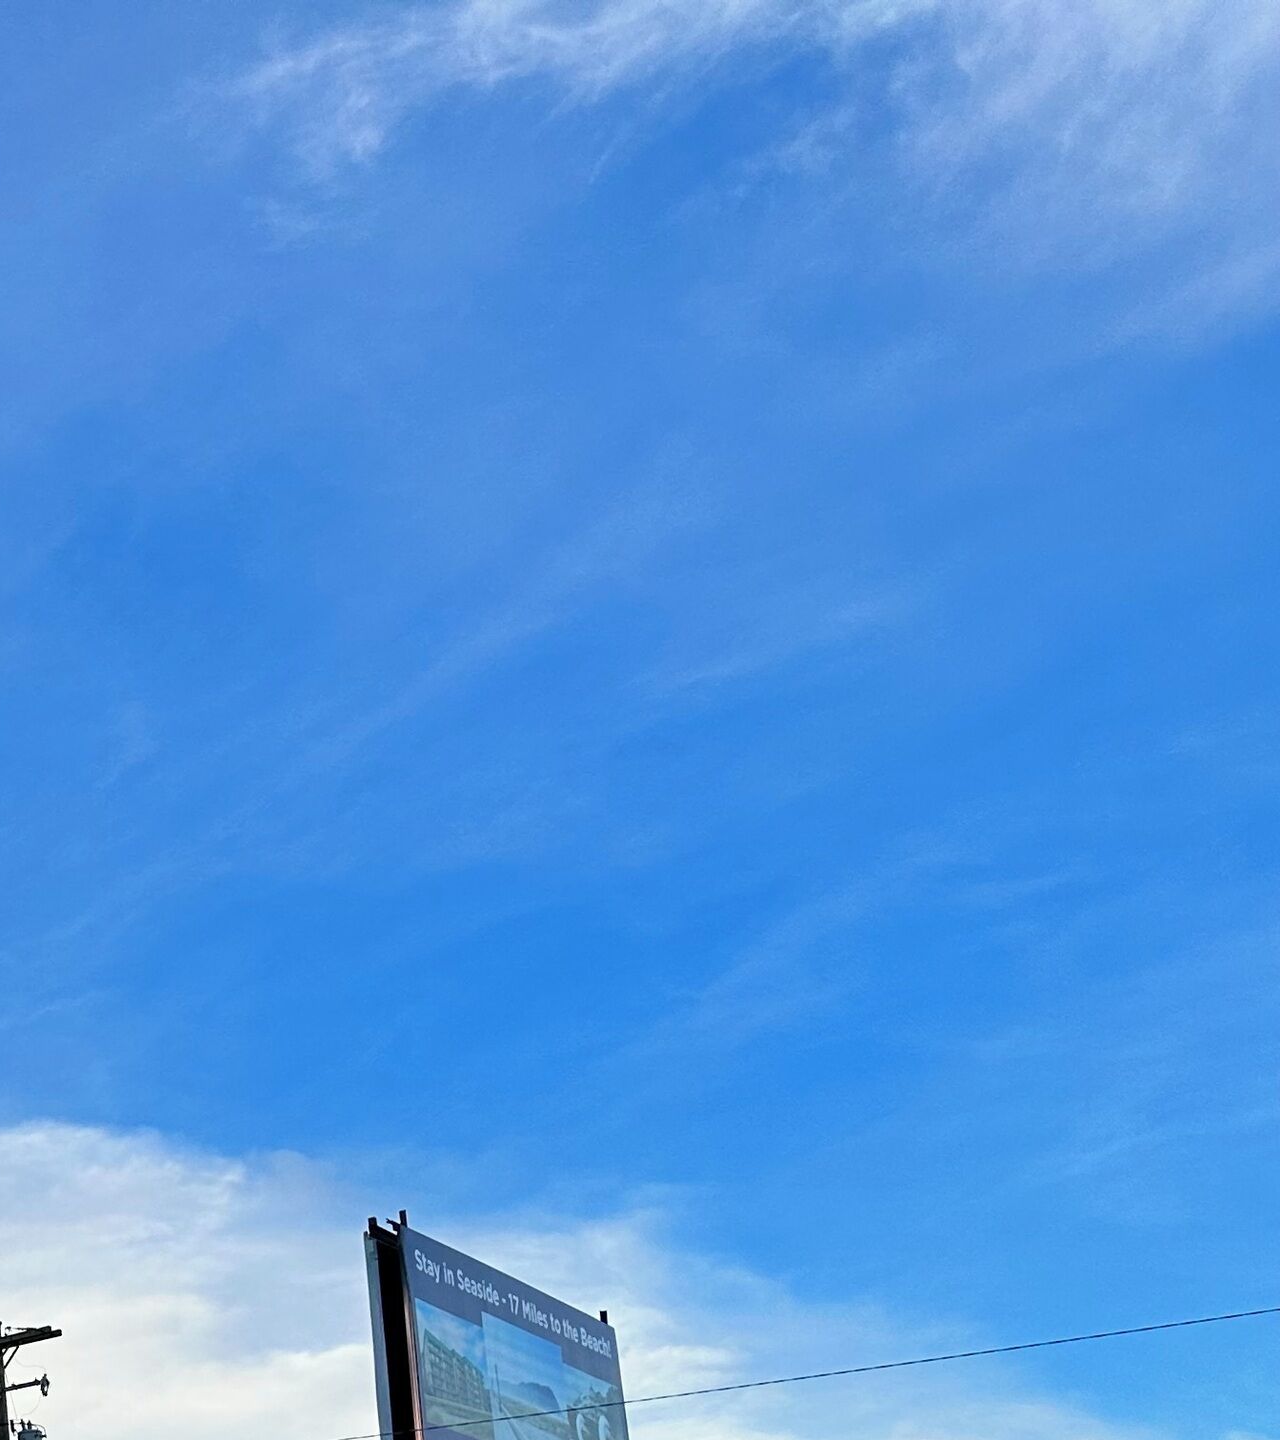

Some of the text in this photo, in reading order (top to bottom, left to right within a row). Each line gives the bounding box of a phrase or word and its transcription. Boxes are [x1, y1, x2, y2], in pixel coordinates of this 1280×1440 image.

[414, 1249, 440, 1284] Stay
[443, 1262, 454, 1287] in
[457, 1268, 500, 1306] Seaside
[508, 1293, 519, 1315] 17
[522, 1300, 548, 1330] Miles
[550, 1313, 561, 1335] to
[562, 1319, 579, 1343] the
[580, 1327, 612, 1359] Beach!
